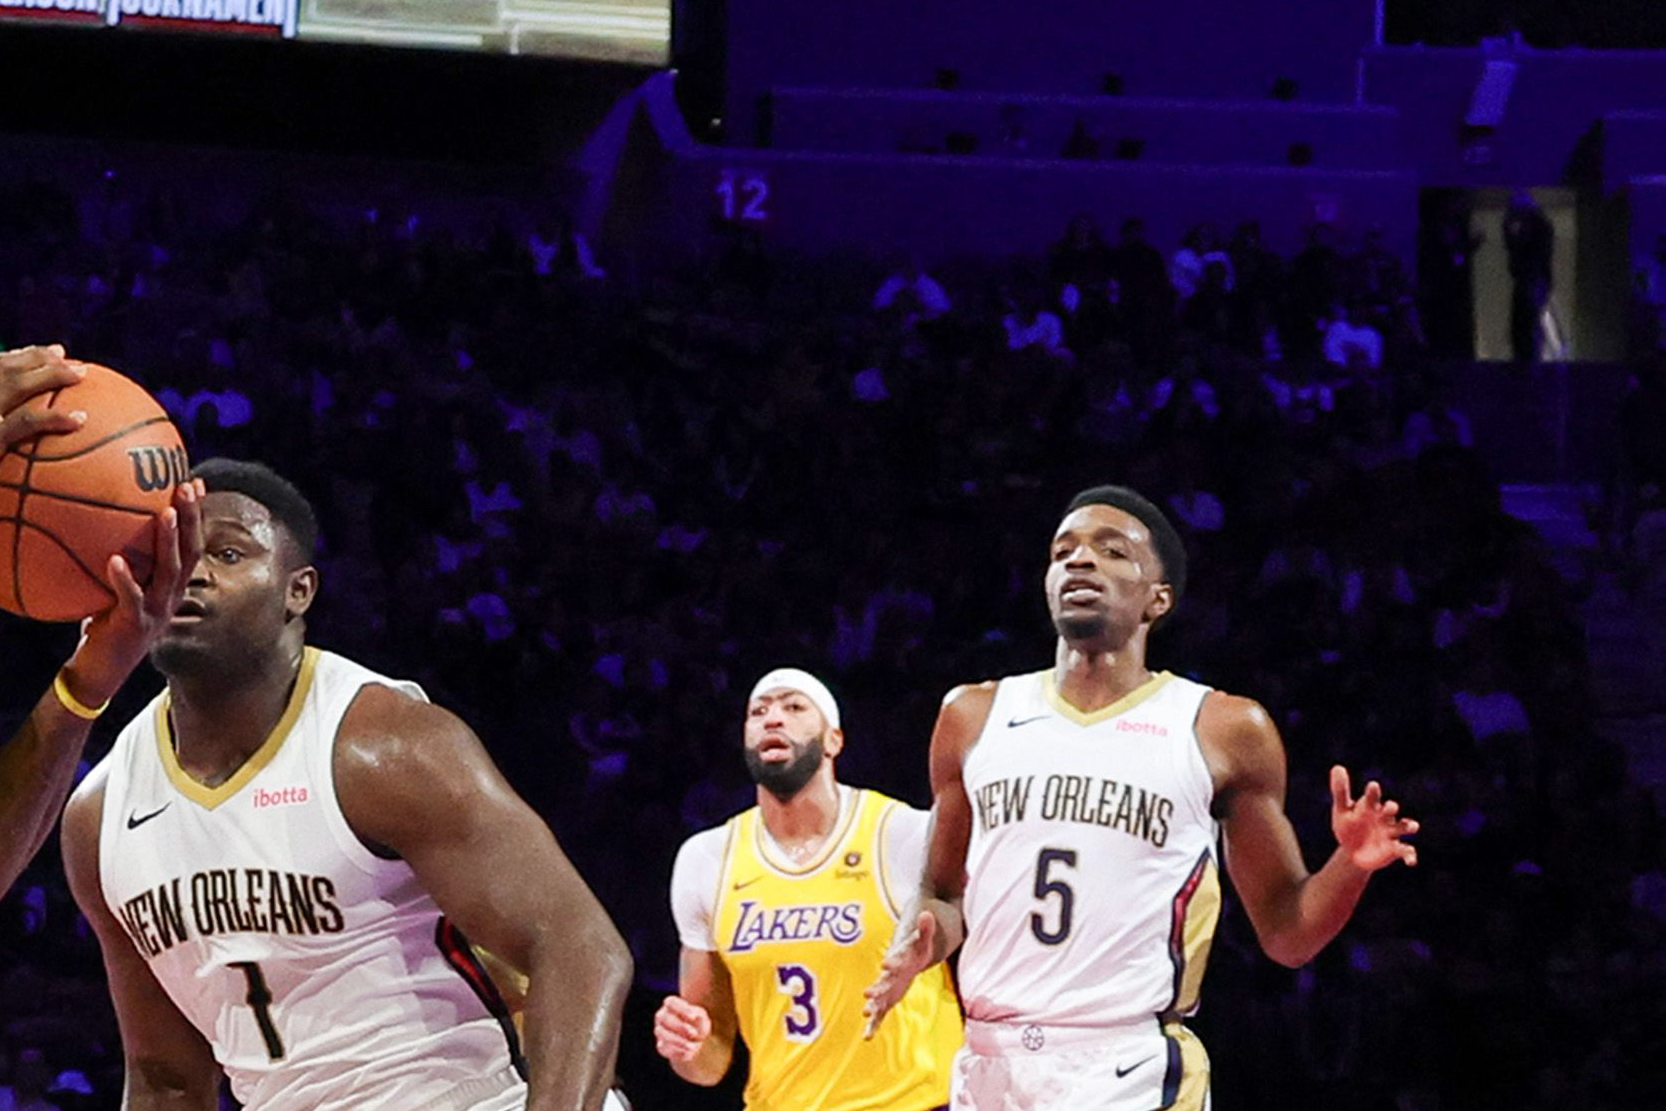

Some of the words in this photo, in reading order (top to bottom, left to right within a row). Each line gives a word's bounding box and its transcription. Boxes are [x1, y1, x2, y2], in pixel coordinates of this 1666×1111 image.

[716, 177, 769, 221] 12
[1116, 719, 1168, 737] ibotta
[254, 787, 308, 808] ibotta
[975, 775, 1035, 833] NEW
[1041, 774, 1175, 848] ORLEANS
[118, 876, 188, 957] NEW
[190, 867, 345, 936] ORLEANS
[729, 902, 863, 952] LAKERS
[1031, 847, 1077, 946] 5
[225, 961, 286, 1062] 1
[776, 964, 820, 1040] 3
